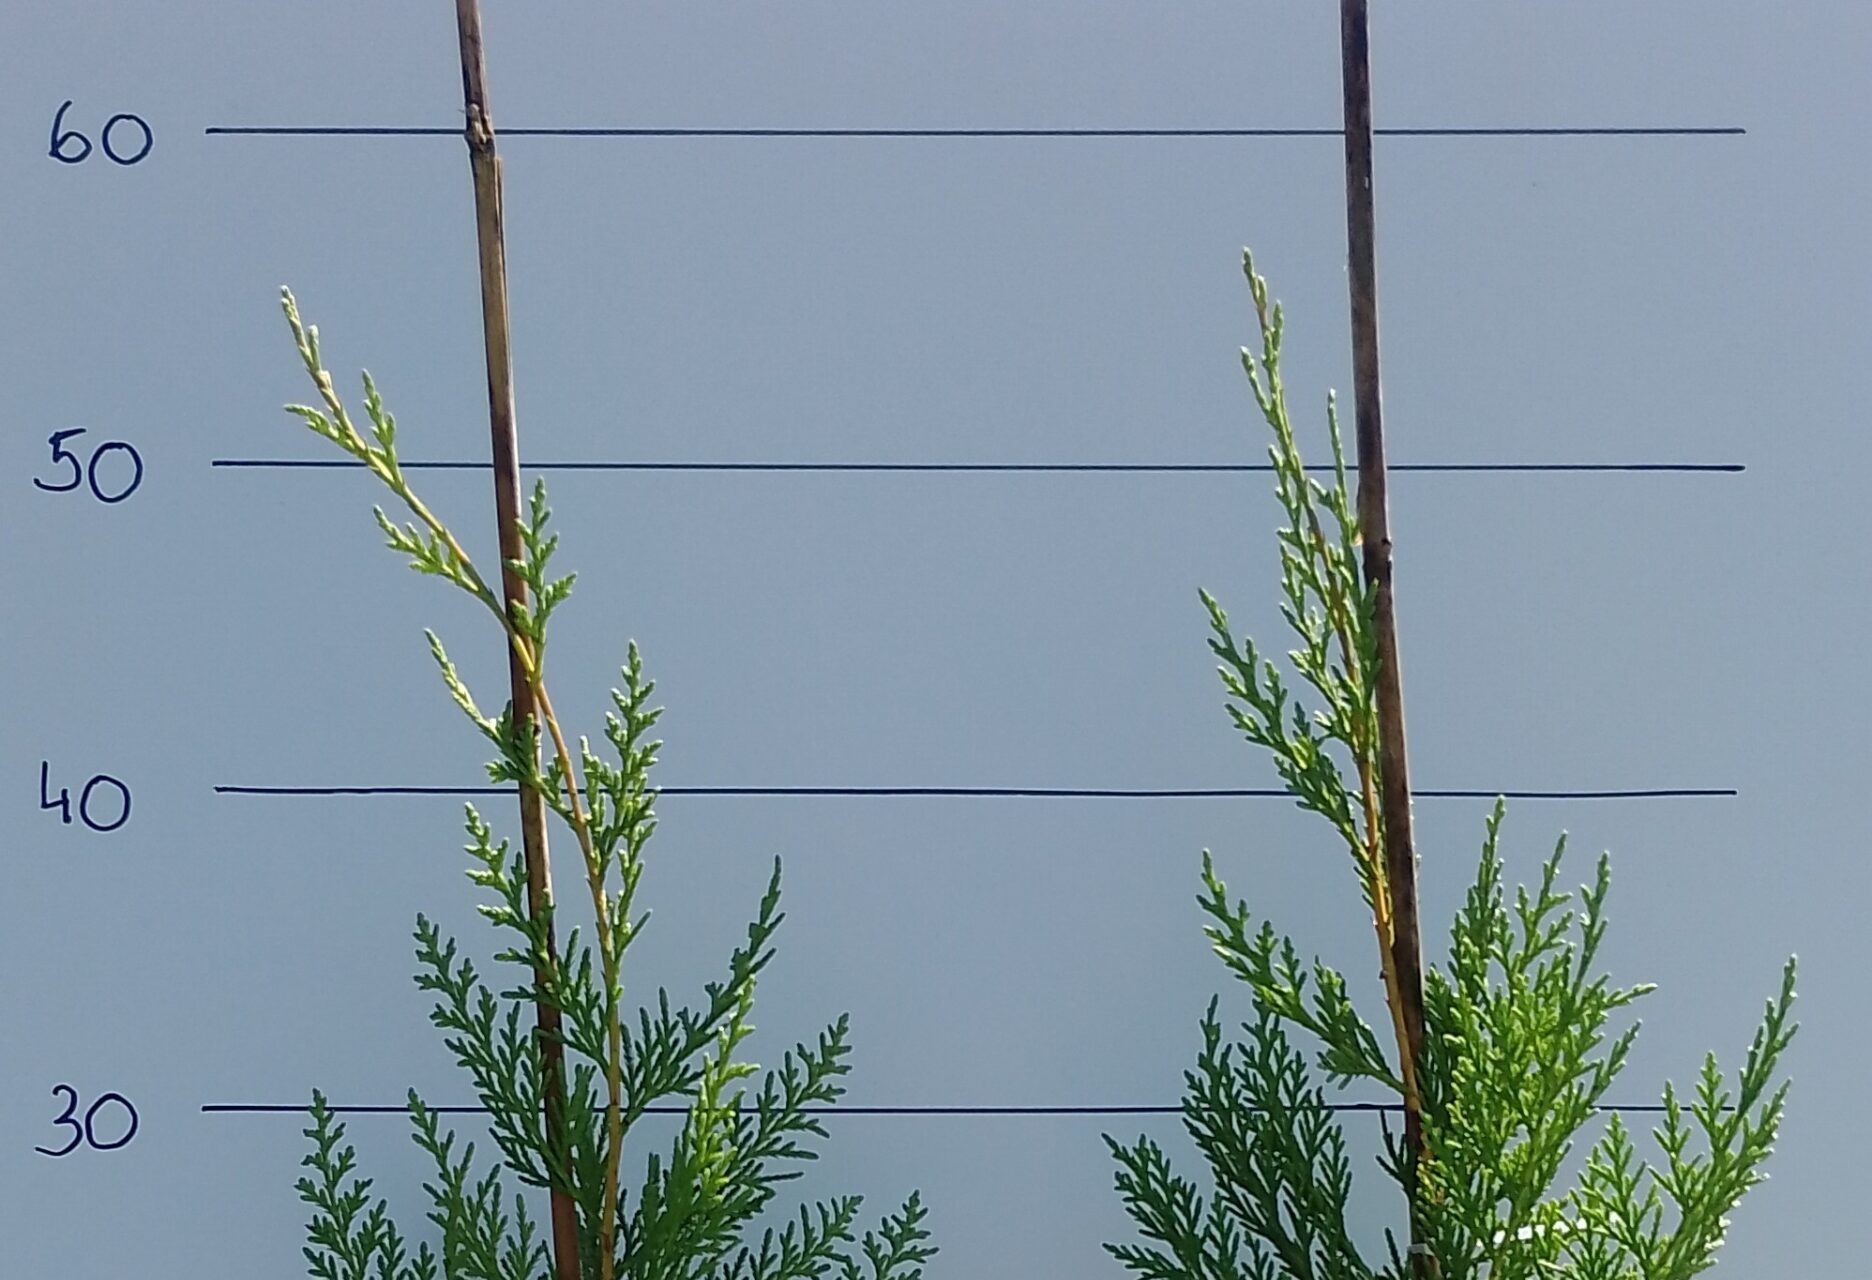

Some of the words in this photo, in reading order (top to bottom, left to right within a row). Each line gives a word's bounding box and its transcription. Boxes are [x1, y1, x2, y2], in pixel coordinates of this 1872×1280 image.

[48, 99, 153, 166] 60
[33, 427, 143, 504] 50
[40, 760, 131, 832] 40
[34, 1084, 139, 1157] 30
